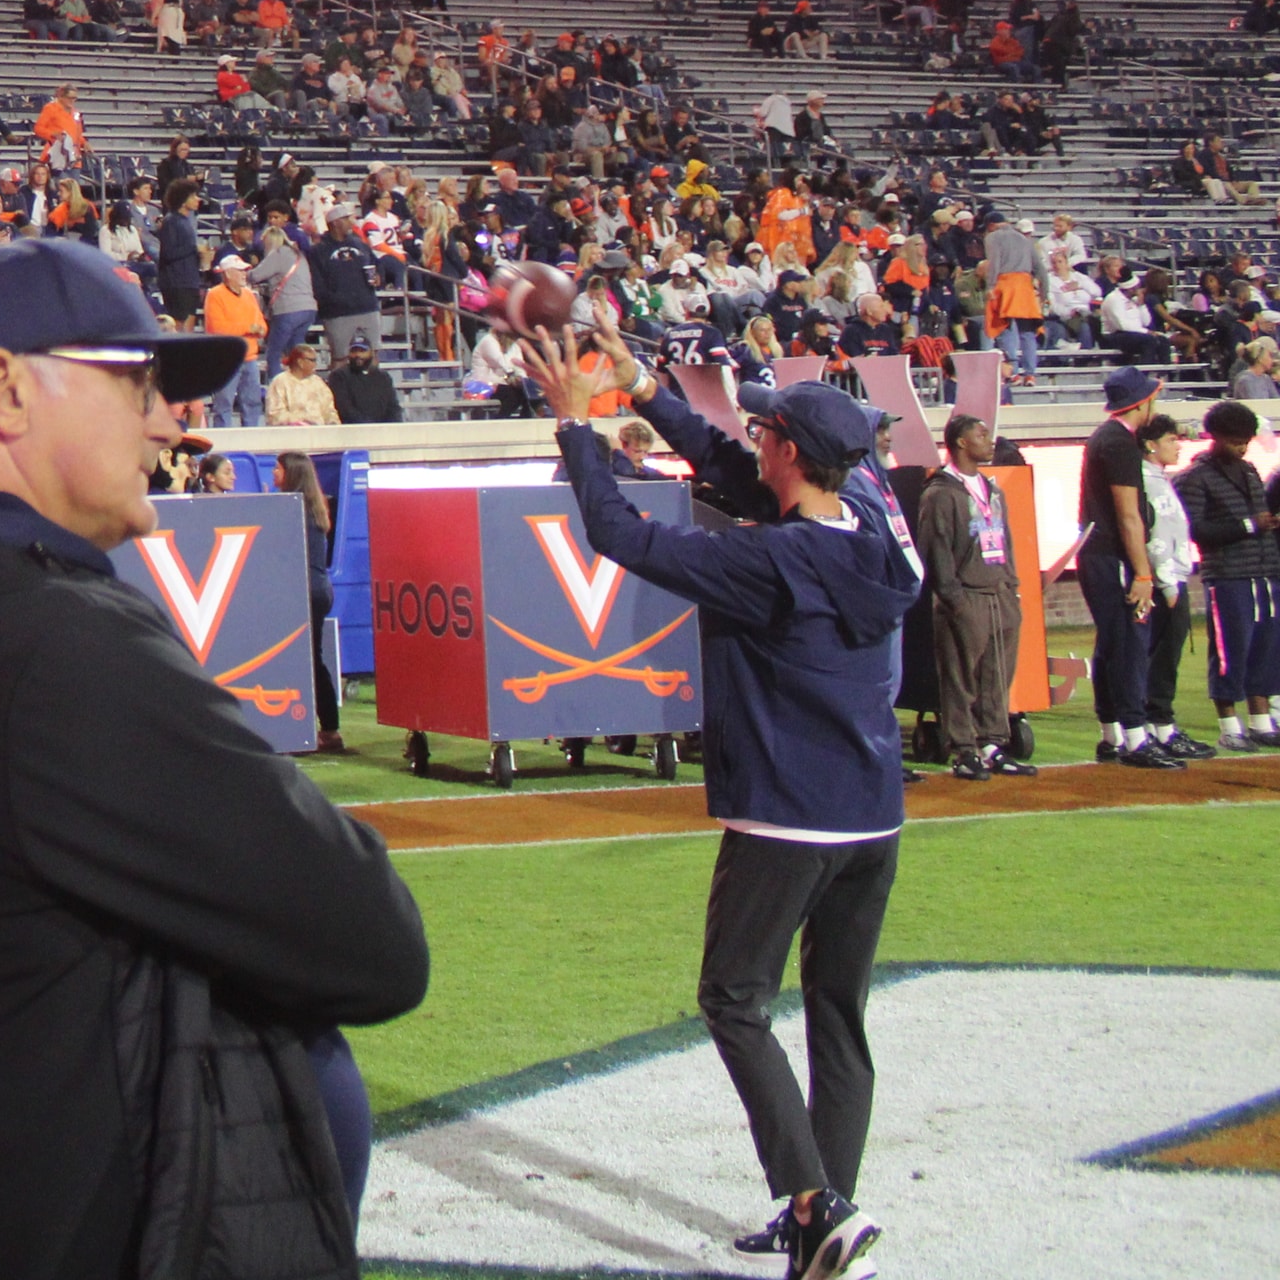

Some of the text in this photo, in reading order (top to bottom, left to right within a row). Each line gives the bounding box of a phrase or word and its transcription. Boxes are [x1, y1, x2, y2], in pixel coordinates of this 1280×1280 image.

[668, 340, 704, 366] 36
[134, 526, 262, 667] V
[375, 578, 474, 641] HOOS
